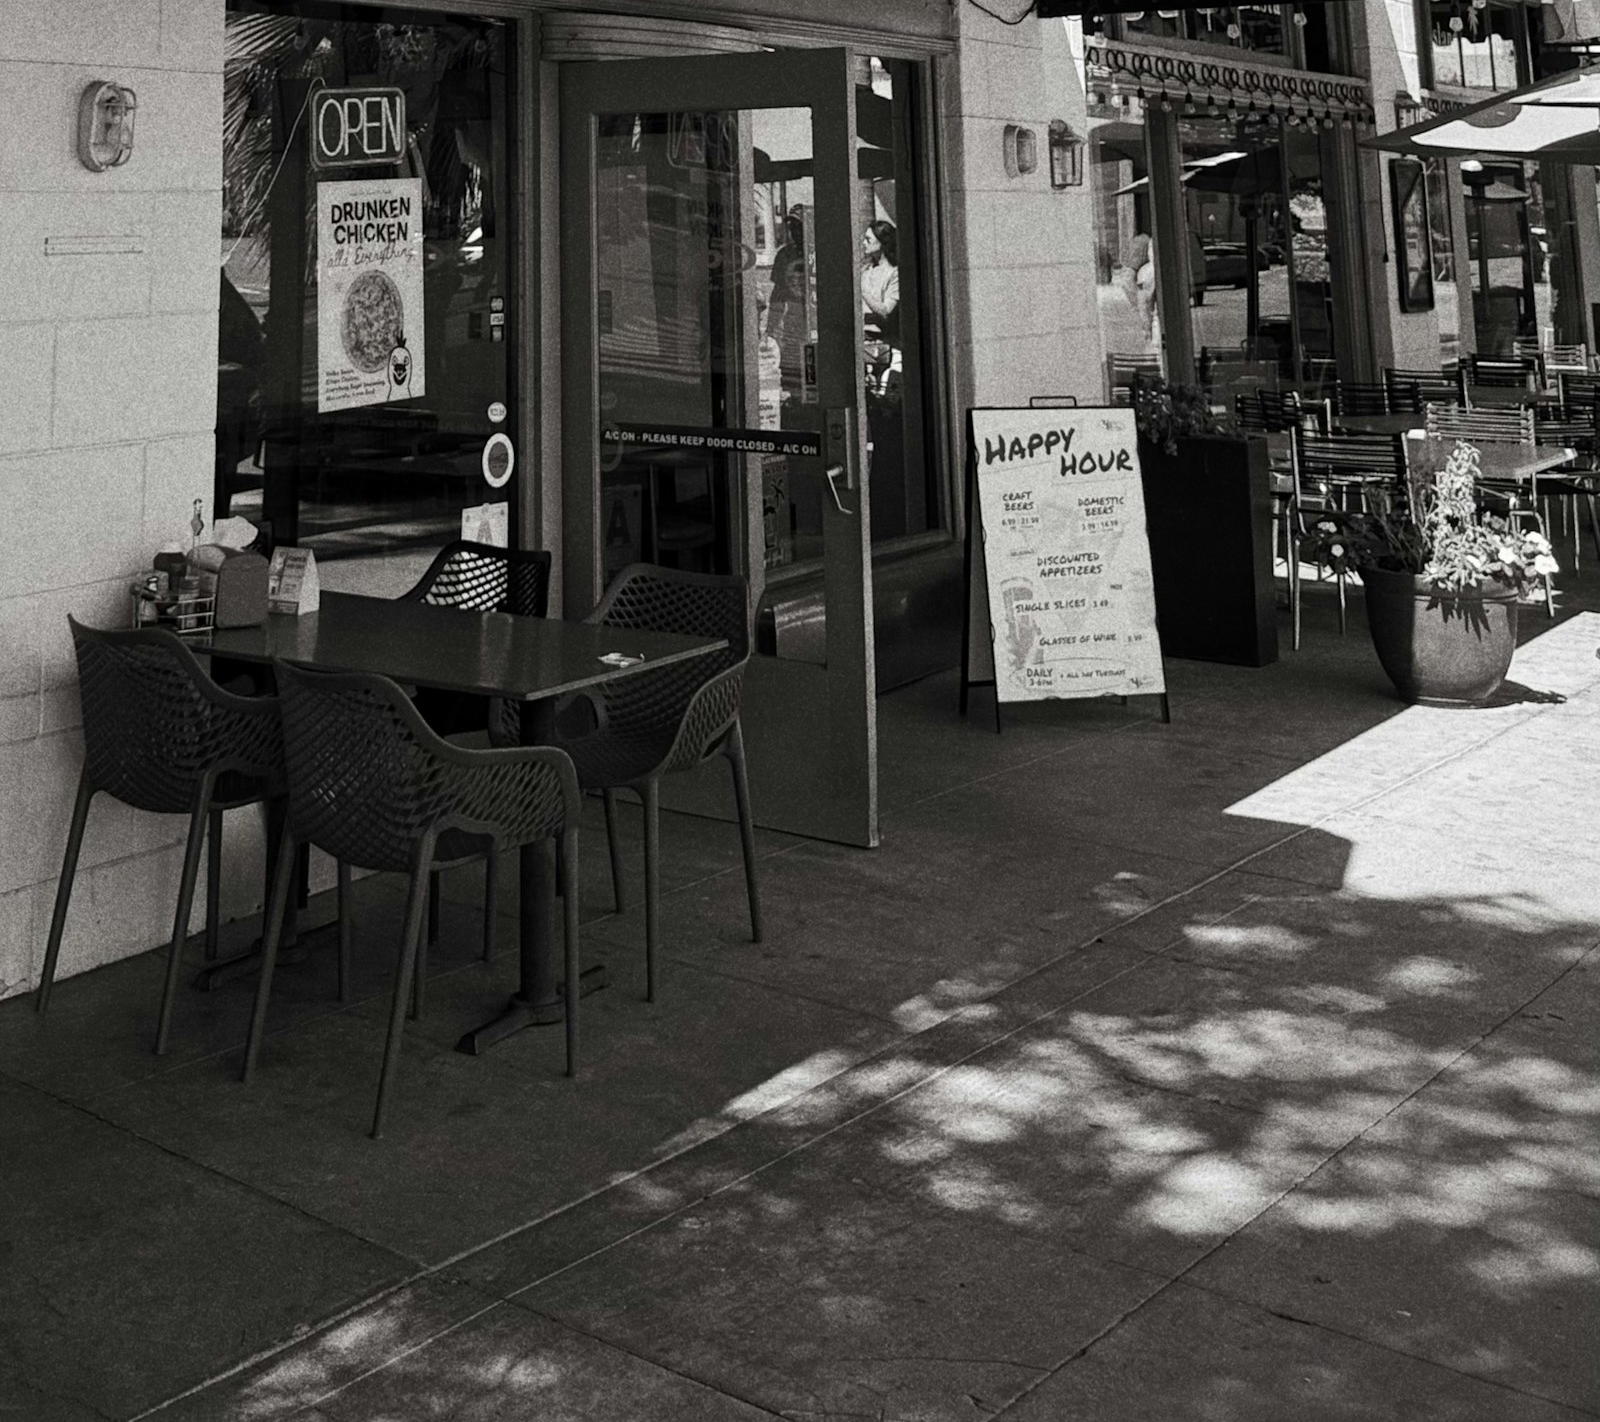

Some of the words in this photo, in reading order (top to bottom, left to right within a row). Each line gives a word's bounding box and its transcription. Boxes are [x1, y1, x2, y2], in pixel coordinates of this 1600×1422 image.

[319, 96, 401, 156] OPEN
[331, 196, 410, 224] DRUNKEN
[334, 221, 408, 244] CHICKEN
[605, 430, 619, 441] A/C
[622, 431, 635, 441] ON
[642, 434, 678, 445] PLEASE
[679, 435, 705, 446] KEEP
[707, 438, 734, 449] DOOR
[736, 439, 775, 452] CLOSED
[783, 444, 799, 454] A/C
[802, 445, 817, 455] ON
[985, 428, 1075, 465] HAPPY
[1060, 449, 1133, 476] HOUR
[1003, 491, 1033, 502] CRAFT
[1077, 496, 1125, 507] DOMESTIC
[1005, 502, 1034, 512] BEERS
[1085, 506, 1114, 517] BEERS
[1037, 552, 1100, 567] DISCOUNTED
[1040, 564, 1103, 578] APPETIZERS
[1015, 601, 1050, 614] SINGLE
[1054, 599, 1087, 610] SLICES
[1039, 636, 1076, 646] GLASSES
[1080, 635, 1090, 643] OF
[1093, 634, 1117, 643] WINE
[1026, 668, 1054, 678] DAILY
